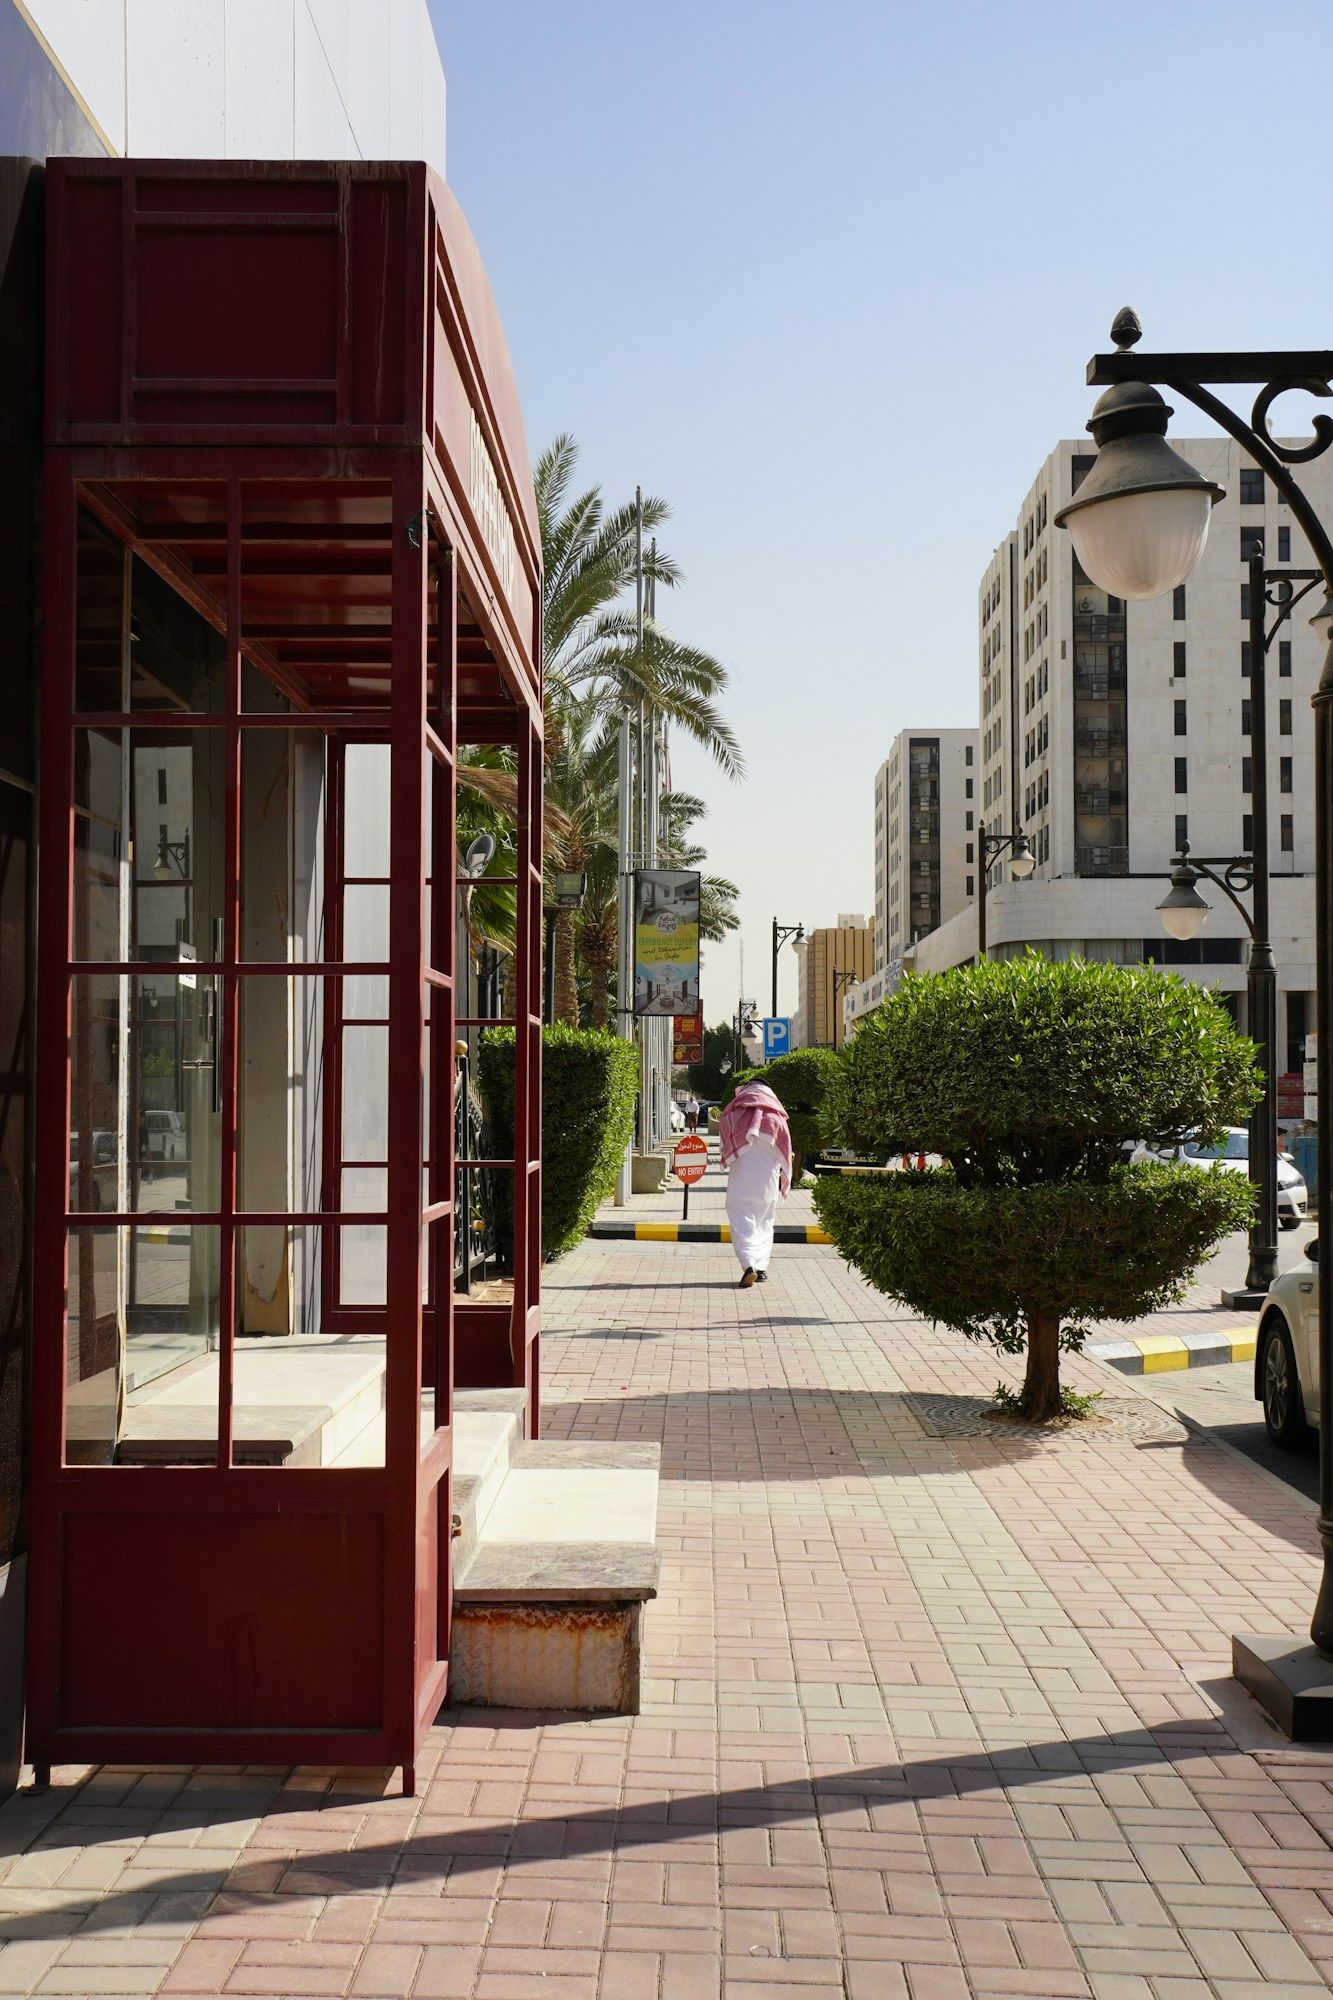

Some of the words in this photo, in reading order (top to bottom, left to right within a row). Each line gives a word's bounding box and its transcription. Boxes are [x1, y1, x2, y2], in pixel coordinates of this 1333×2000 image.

[470, 408, 498, 569] COFFEE
[638, 937, 673, 946] EXPERIENCE
[674, 937, 697, 947] LUXURY
[768, 1022, 787, 1047] P
[678, 1142, 692, 1151] الدخول
[678, 1168, 687, 1176] NO
[687, 1166, 704, 1176] ENTRY
